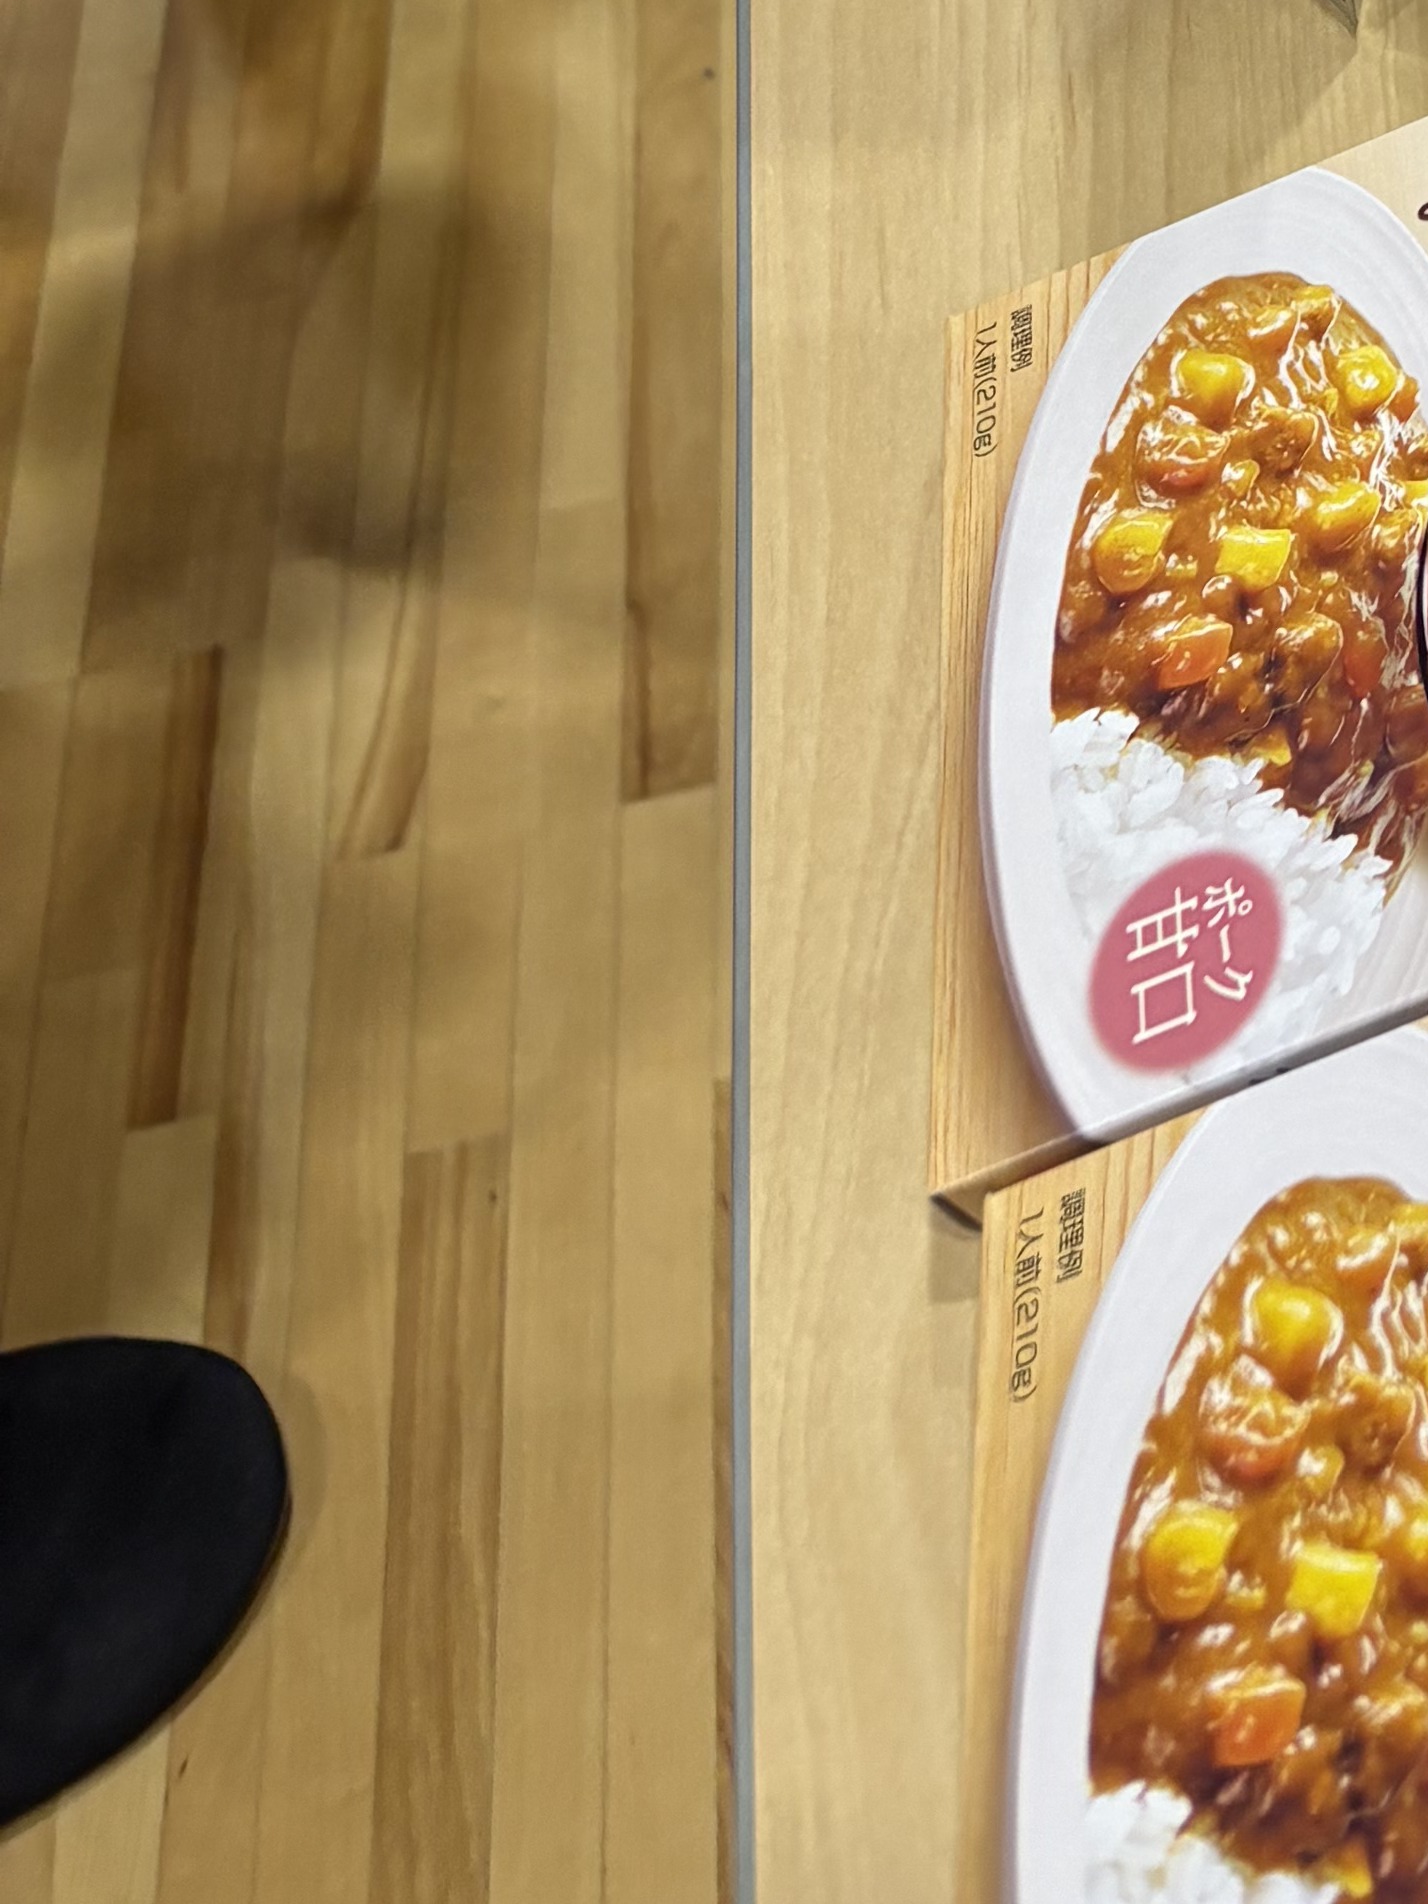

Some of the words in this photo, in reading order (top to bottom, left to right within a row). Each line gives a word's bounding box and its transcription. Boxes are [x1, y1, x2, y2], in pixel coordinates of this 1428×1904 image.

[1009, 302, 1034, 372] 調理例
[1125, 892, 1198, 1044] 甘口
[1201, 875, 1256, 1000] ポーク
